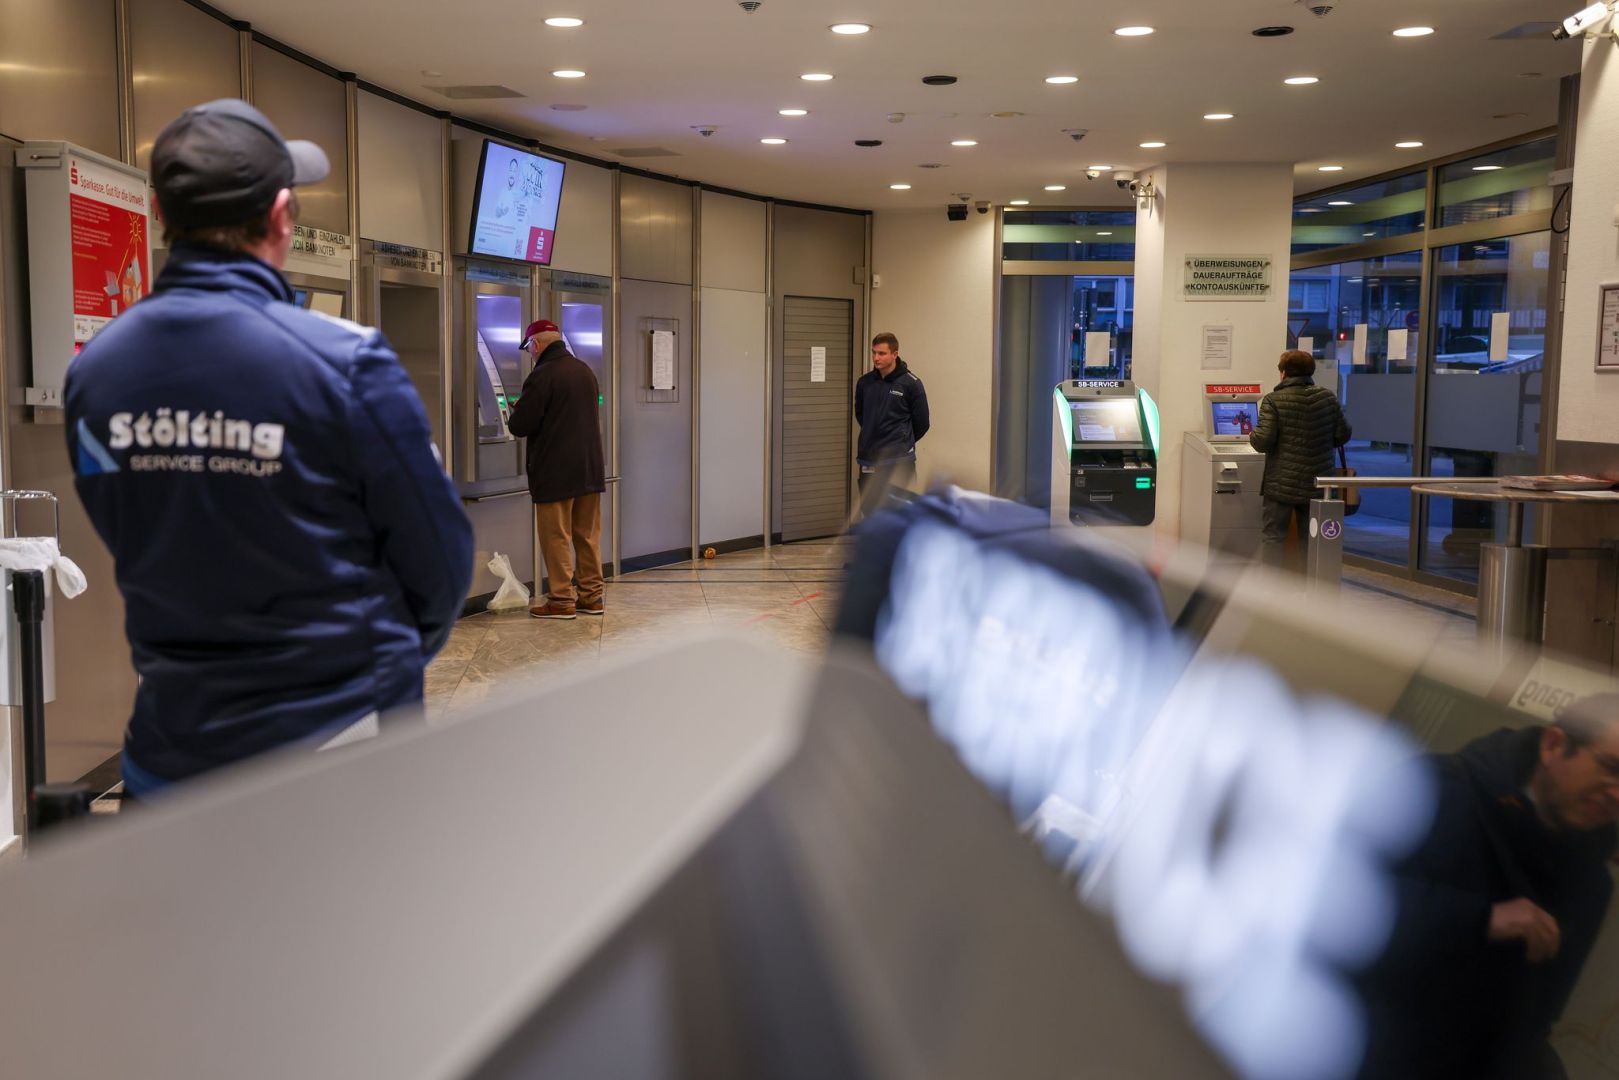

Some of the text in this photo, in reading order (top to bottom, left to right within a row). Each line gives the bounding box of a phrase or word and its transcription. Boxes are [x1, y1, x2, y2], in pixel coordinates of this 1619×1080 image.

[80, 175, 105, 194] Sparkasse.
[105, 183, 114, 197] Gut
[121, 189, 129, 201] die
[128, 191, 145, 207] Umwelt.
[1194, 258, 1263, 268] ÜBERWEISUNGEN
[1193, 270, 1263, 279] DAUERAUFTRÄGE
[1190, 282, 1265, 291] KONTOAUSKÜNFTE
[1078, 380, 1119, 388] SB-SERVICE
[1213, 385, 1254, 393] SB-SERVICE
[108, 407, 285, 460] Stölting
[129, 454, 283, 477] SERVICE GROUP
